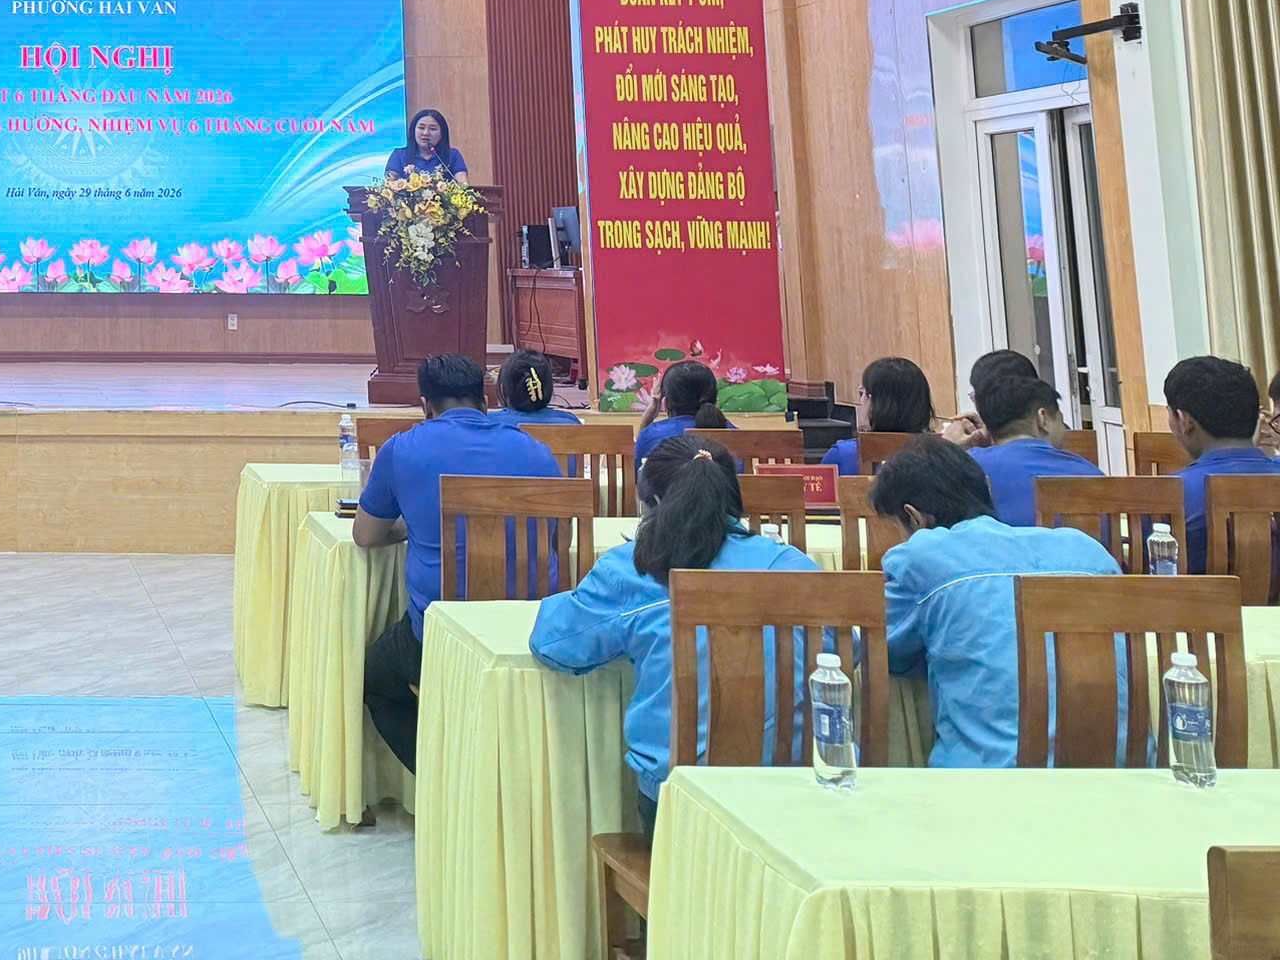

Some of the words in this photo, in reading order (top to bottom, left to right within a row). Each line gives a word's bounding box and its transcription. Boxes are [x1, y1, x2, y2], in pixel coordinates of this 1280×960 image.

[20, 41, 80, 76] HỘI
[89, 44, 174, 76] NGHỊ
[595, 20, 629, 54] PHÁT
[632, 26, 657, 54] HUY
[660, 21, 703, 54] TRÁCH
[706, 21, 754, 60] NHIỆM,
[15, 88, 24, 104] 6
[28, 85, 97, 104] THÁNG
[195, 88, 233, 104] 2026
[616, 63, 638, 102] ĐỔI
[642, 68, 667, 102] MỚI
[671, 69, 707, 102] SÁNG
[710, 74, 738, 108] TẠO,
[88, 115, 153, 136] NHIỆM
[158, 118, 182, 136] VỤ
[188, 117, 200, 133] 6
[204, 114, 272, 133] THÁNG
[330, 114, 375, 133] NĂM
[612, 117, 650, 150] NÂNG
[653, 122, 679, 151] CAO
[683, 117, 712, 157] HIỆU
[716, 113, 747, 154] QUẢ,
[79, 187, 92, 198] 29
[124, 187, 131, 198] 6
[157, 187, 182, 198] 2026
[619, 165, 644, 200] XÂY
[648, 170, 684, 205] DỰNG
[687, 163, 724, 200] ĐẢNG
[728, 167, 746, 206] BỘ
[598, 220, 641, 249] TRONG
[645, 220, 685, 255] SẠCH,
[687, 215, 723, 249] VỮNG
[726, 220, 771, 256] MẠNH!
